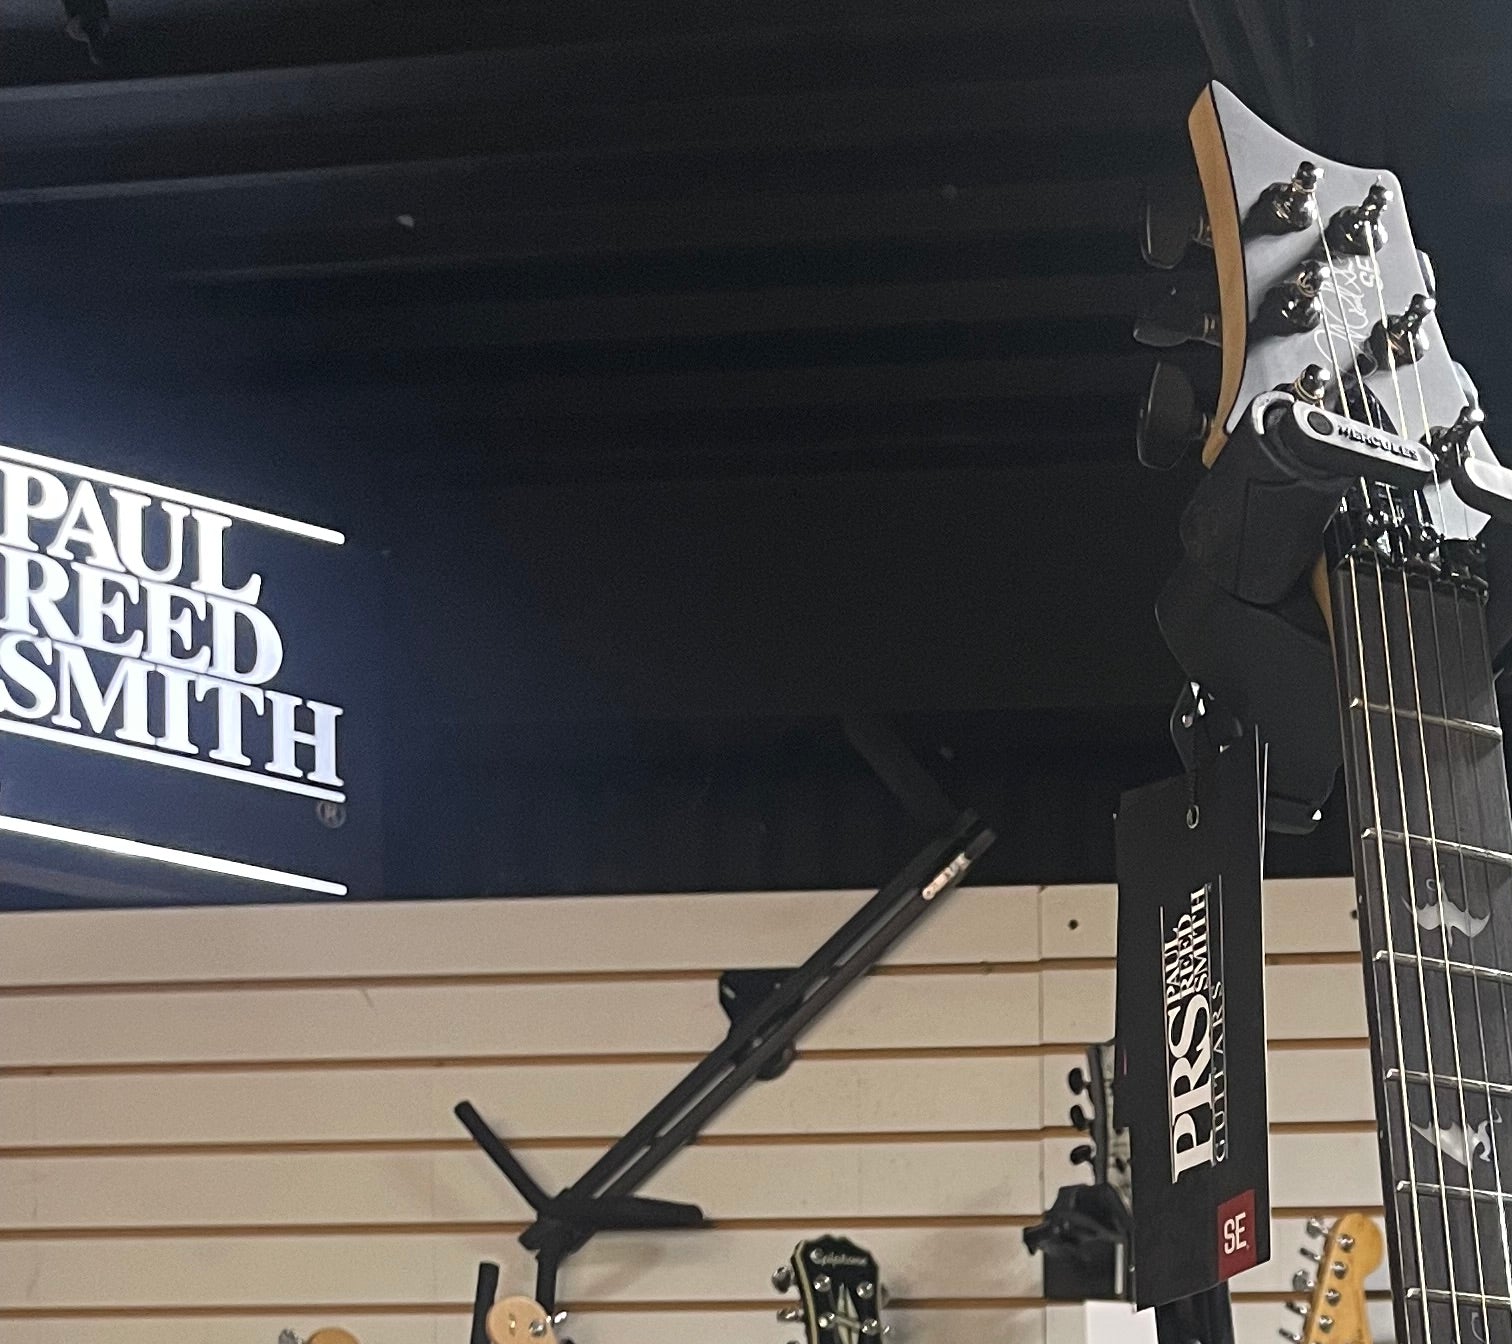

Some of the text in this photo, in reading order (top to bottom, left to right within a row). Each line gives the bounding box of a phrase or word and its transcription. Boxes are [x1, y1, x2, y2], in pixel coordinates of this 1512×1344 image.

[1338, 424, 1419, 461] HERCULES
[0, 460, 262, 605] PAUL
[0, 550, 283, 686] REED
[0, 631, 345, 787] SMITH
[1164, 926, 1180, 1002] PAUL
[1178, 913, 1193, 998] REED
[1190, 884, 1208, 993] SMITH
[1168, 994, 1215, 1183] PRS
[1211, 981, 1226, 1163] GUITARS
[1223, 1211, 1247, 1255] SE
